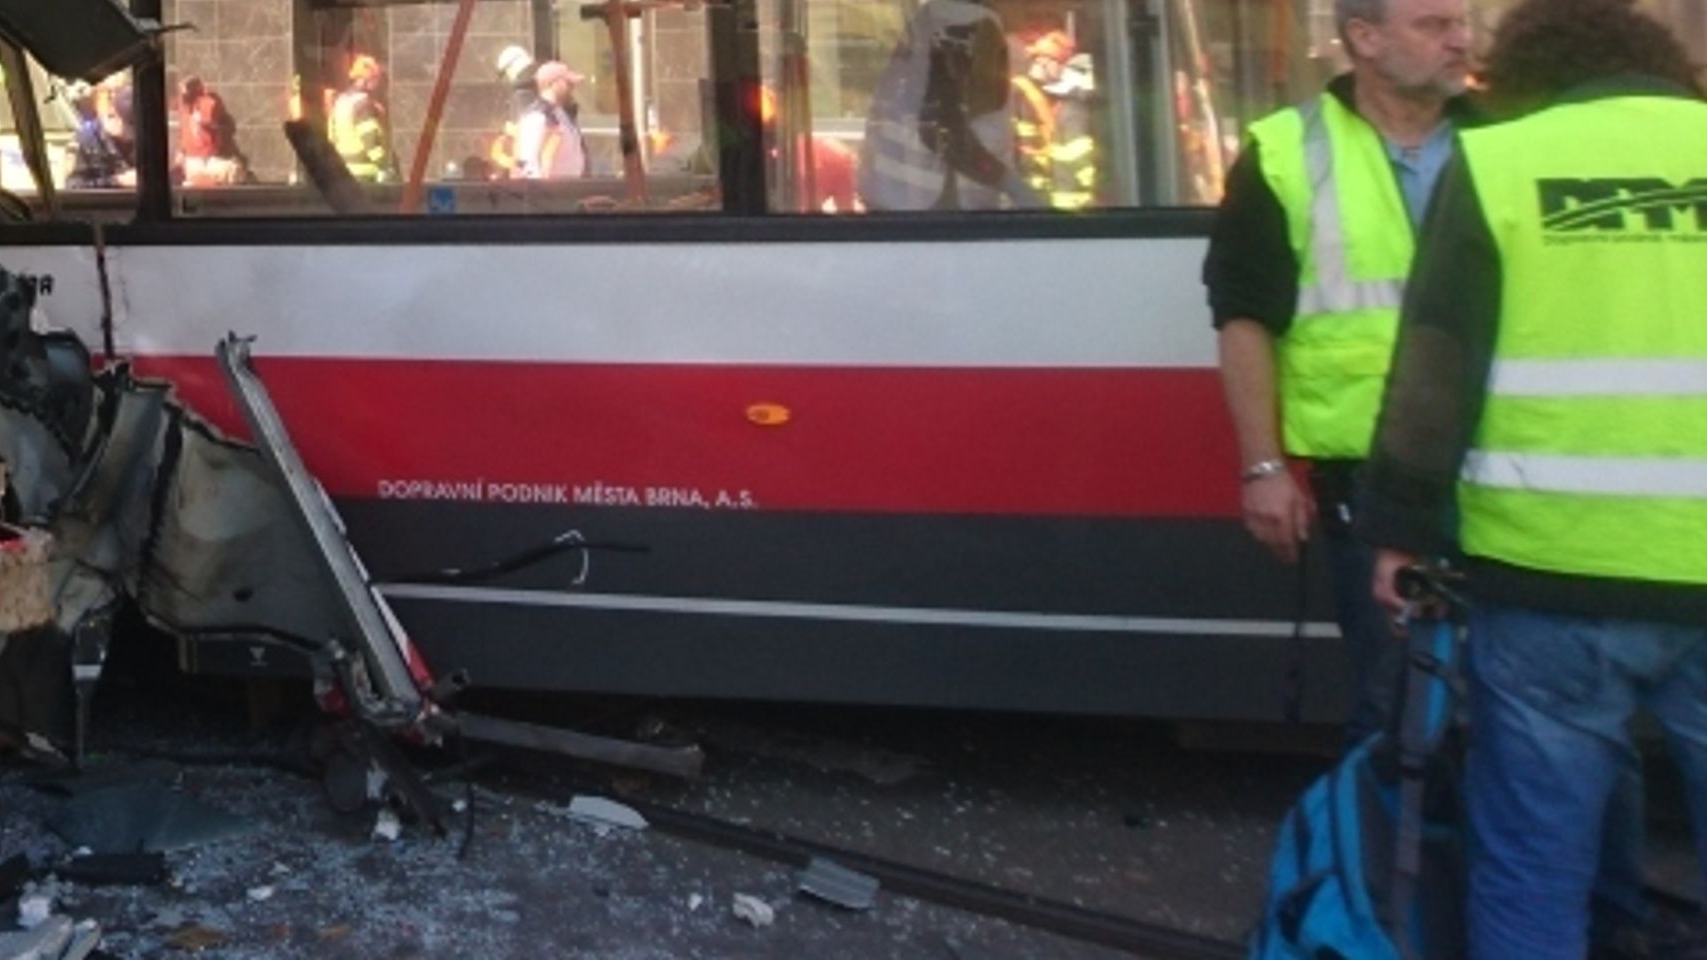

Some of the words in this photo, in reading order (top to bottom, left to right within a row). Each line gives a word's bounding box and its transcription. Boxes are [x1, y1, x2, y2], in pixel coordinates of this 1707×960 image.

[1537, 177, 1707, 230] DPM
[377, 478, 483, 501] DOPRAVNÍ
[487, 483, 568, 504] PODNIK
[572, 481, 641, 507] MĚSTA
[644, 487, 711, 510] BRNA,
[714, 490, 760, 510] A.S.
